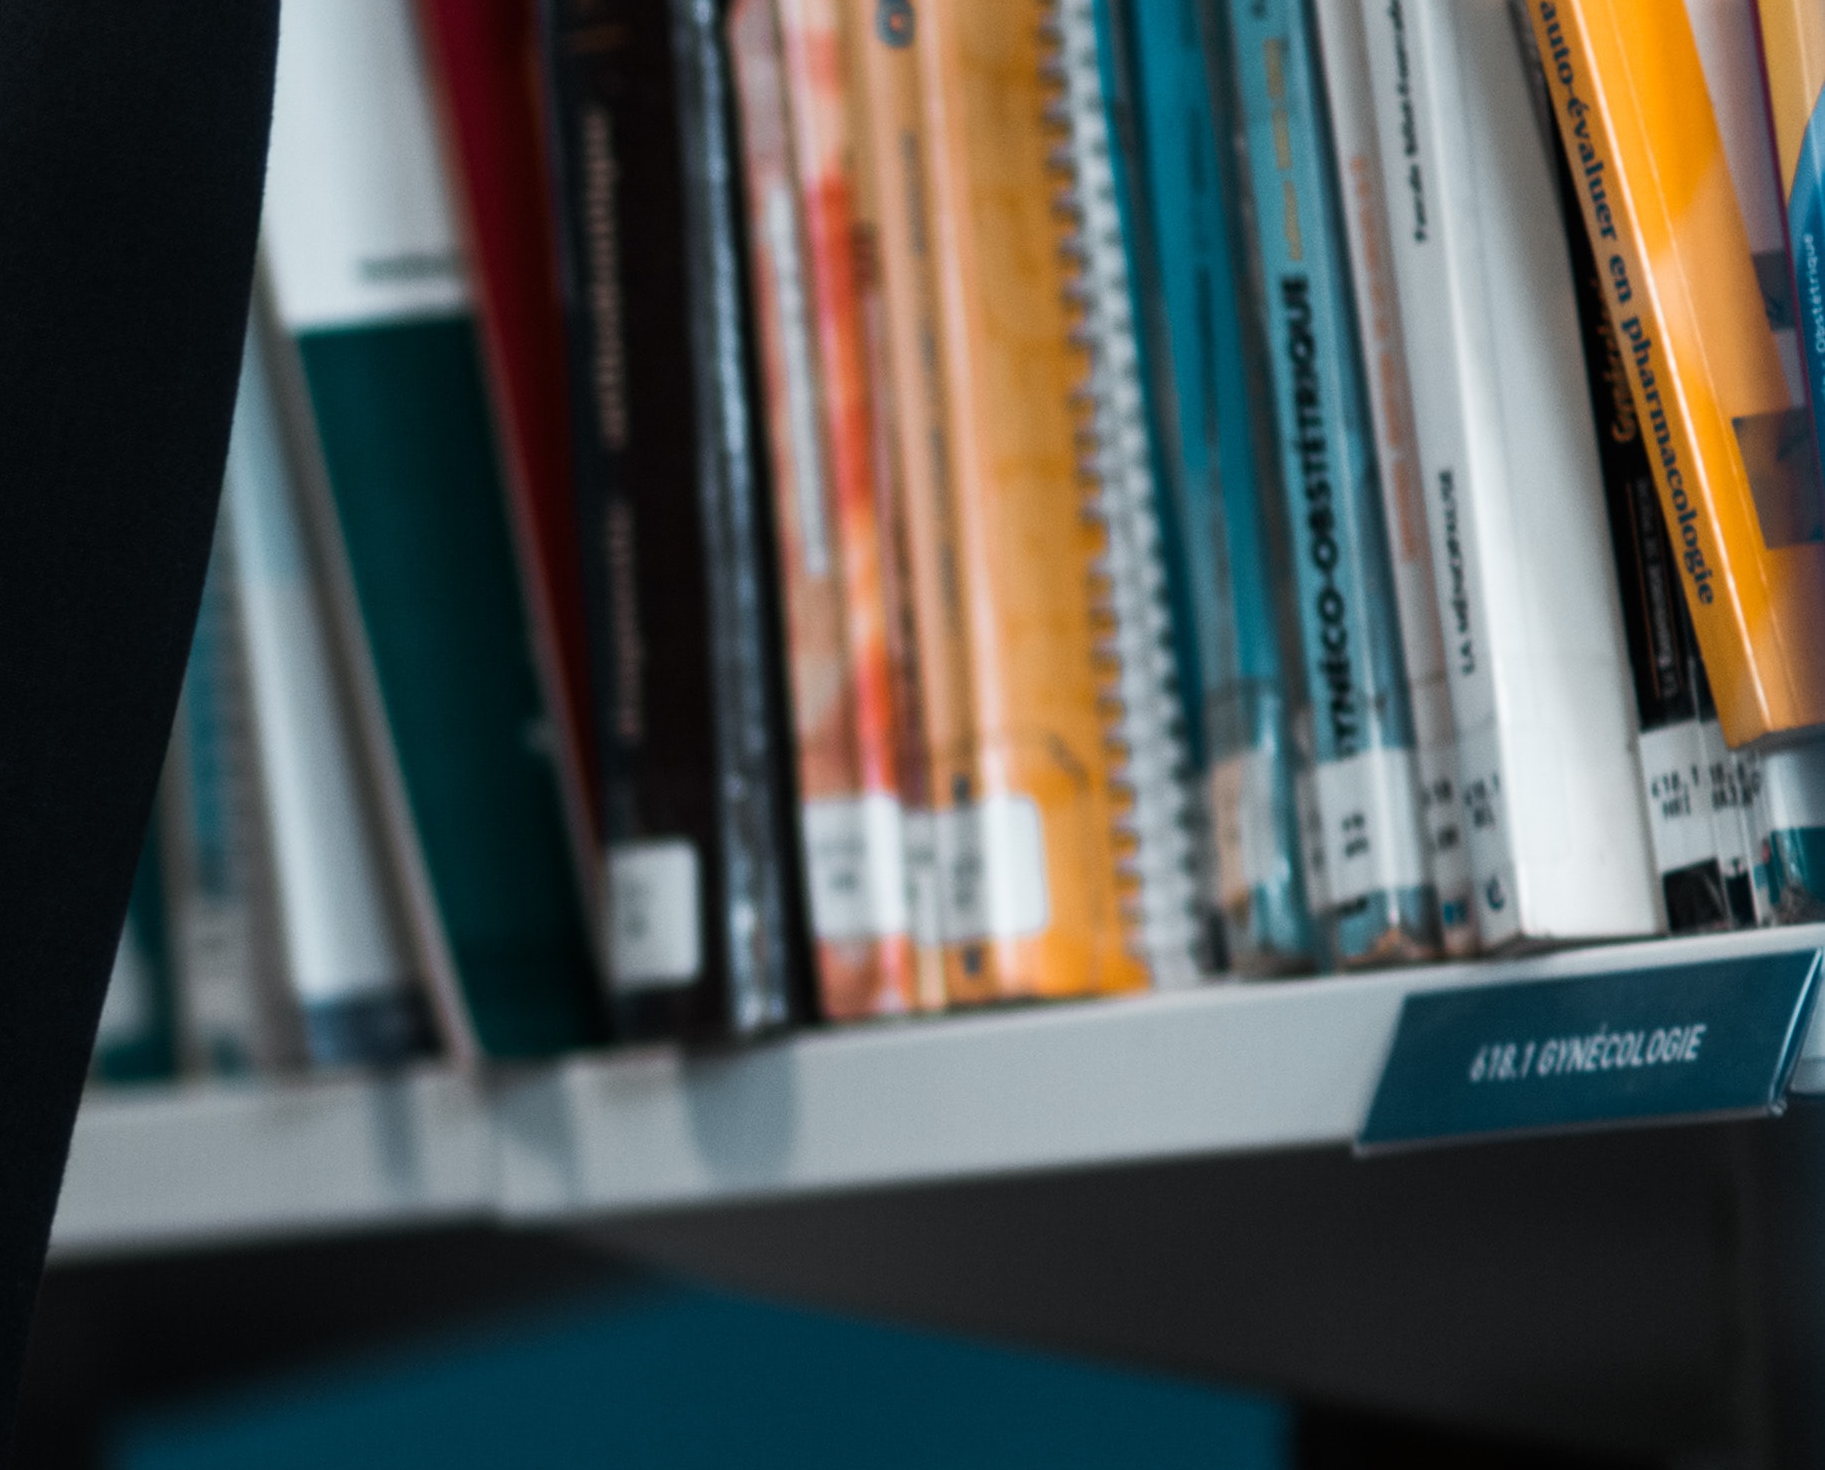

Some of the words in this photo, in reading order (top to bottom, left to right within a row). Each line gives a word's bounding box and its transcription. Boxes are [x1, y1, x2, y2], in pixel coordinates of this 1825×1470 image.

[1609, 253, 1634, 304] en
[1621, 316, 1715, 607] pharmacologie
[1469, 1038, 1536, 1082] 618.1
[1537, 1024, 1707, 1077] GYNÉCOLOGIE
